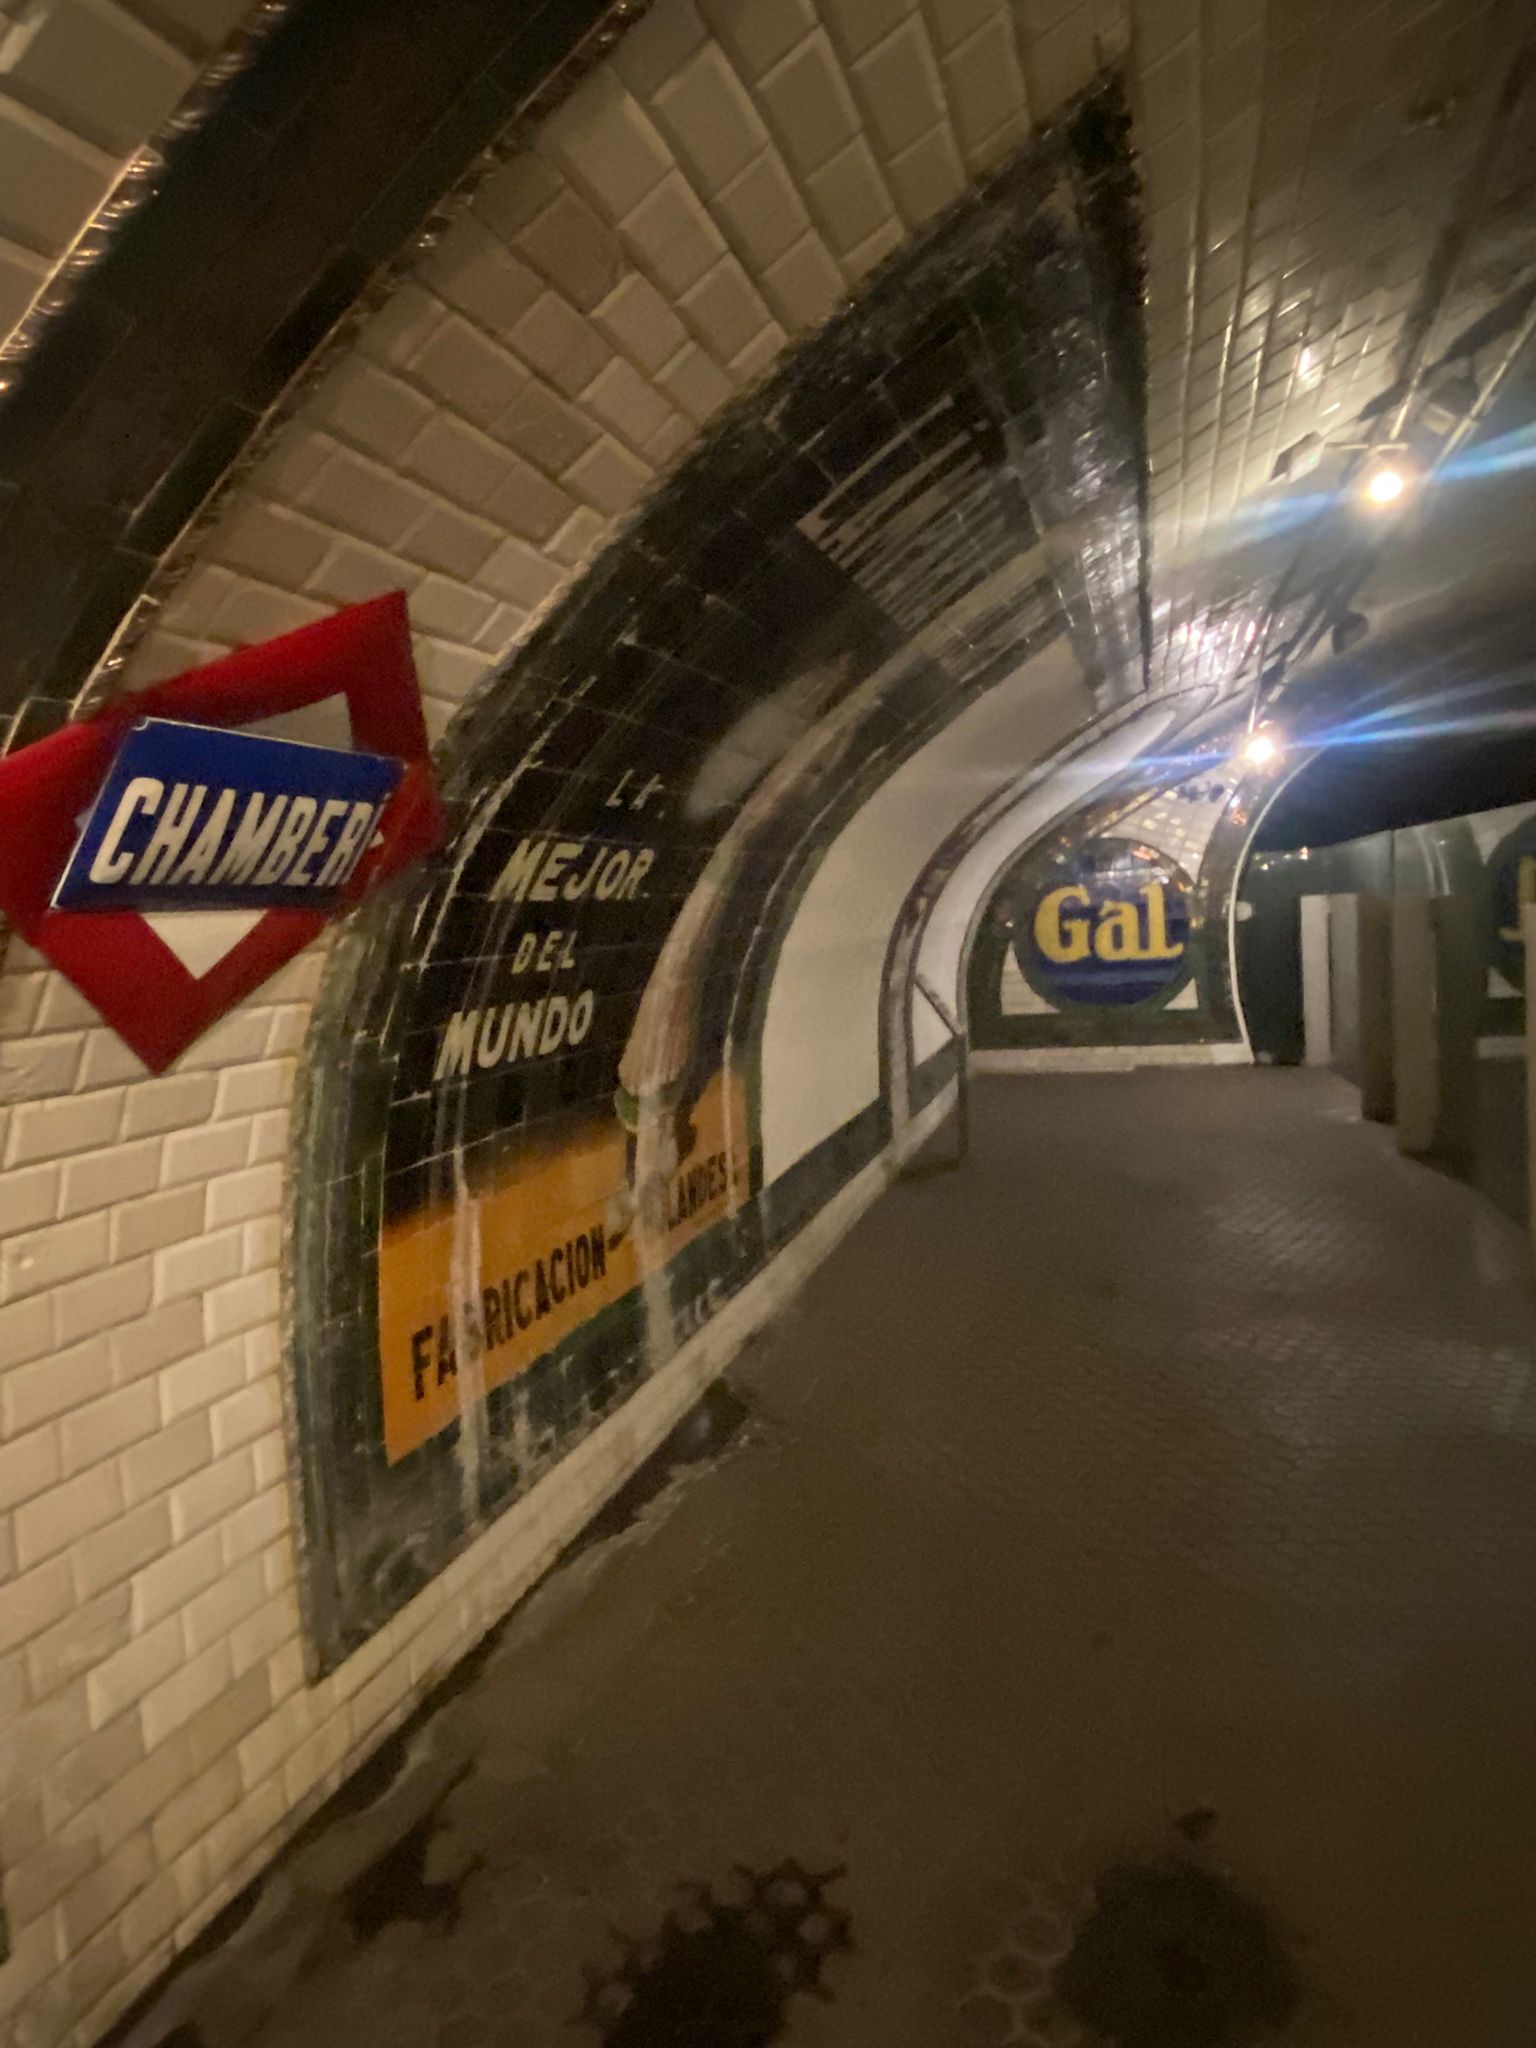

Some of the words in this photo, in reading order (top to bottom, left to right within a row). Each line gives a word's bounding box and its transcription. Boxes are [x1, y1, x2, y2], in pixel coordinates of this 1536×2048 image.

[605, 768, 665, 811] LA
[488, 837, 655, 902] MEJOR
[511, 930, 578, 975] DEL
[1032, 883, 1184, 964] Gal
[433, 989, 595, 1082] MUNDO
